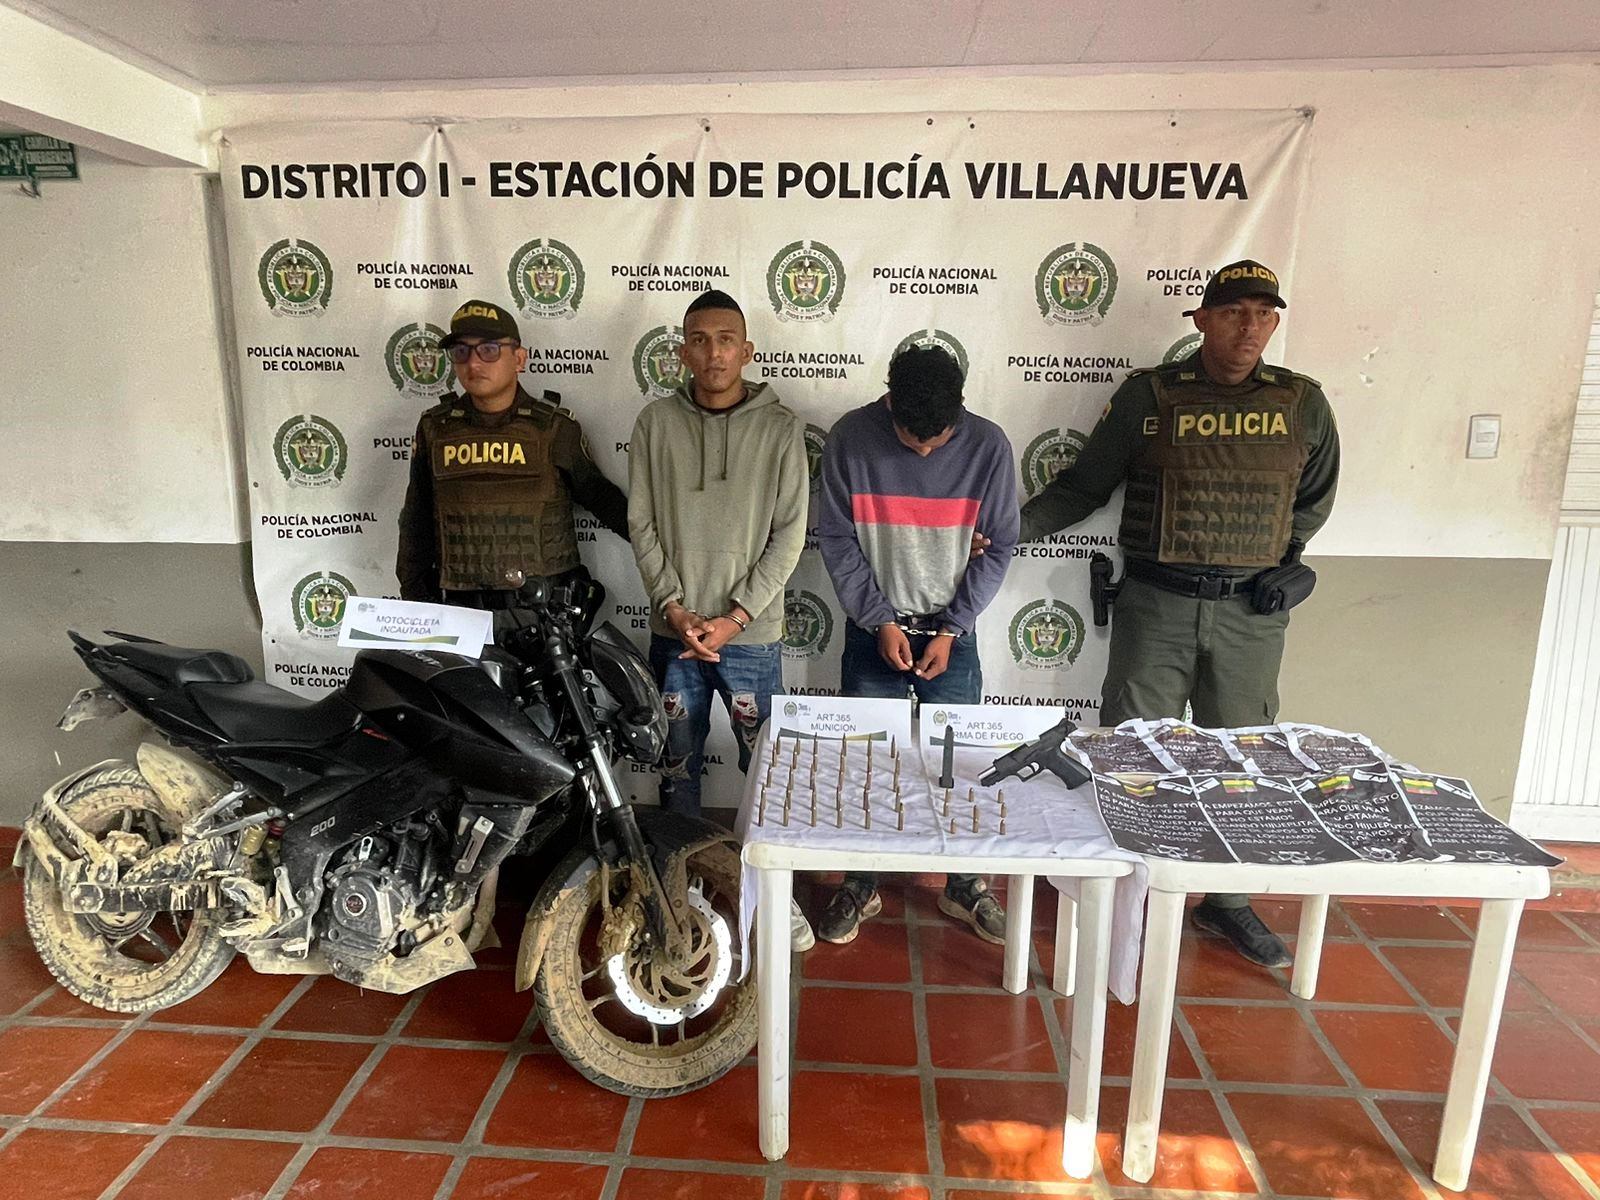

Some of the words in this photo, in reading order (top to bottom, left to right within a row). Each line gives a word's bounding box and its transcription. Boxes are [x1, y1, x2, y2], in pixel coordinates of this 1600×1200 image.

[241, 162, 428, 198] DISTRITO
[438, 162, 449, 197] I
[490, 153, 693, 198] ESTACIÓN
[709, 162, 764, 198] DE
[777, 153, 950, 199] POLICÍA
[965, 163, 1248, 200] VILLANUEVA
[357, 261, 407, 275] POLICÍA
[412, 264, 473, 275] NACIONAL
[611, 263, 660, 277] POLICÍA
[664, 266, 729, 277] NACIONAL
[873, 265, 925, 280] POLICÍA
[929, 268, 997, 280] NACIONAL
[1147, 267, 1201, 281] POLICÍA
[1219, 266, 1278, 284] POLICIA
[374, 278, 392, 289] DE
[396, 278, 458, 289] COLOMBIA
[628, 280, 644, 291] DE
[648, 280, 712, 291] COLOMBIA
[889, 283, 907, 295] DE
[911, 283, 979, 295] COLOMBIA
[1163, 285, 1182, 296] DE
[247, 344, 293, 357] POLICÍA
[297, 346, 360, 358] NACIONAL
[546, 350, 609, 361] NACIONAL
[753, 351, 795, 363] OLICÍA
[799, 354, 864, 365] NACIONAL
[1008, 354, 1059, 368] POLICÍA
[1064, 357, 1132, 369] NACIONAL
[263, 361, 279, 372] DE
[281, 361, 345, 372] COLOMBIA
[529, 363, 594, 374] COLOMBIA
[762, 367, 778, 378] DE
[781, 367, 848, 379] COLOMBIA
[1024, 371, 1041, 382] DE
[1045, 371, 1114, 383] COLOMBIA
[1178, 412, 1289, 437] POLICIA
[374, 436, 415, 448] POLIC
[392, 450, 409, 460] DE
[444, 442, 526, 467] POLICIA
[262, 515, 308, 526] POLICÍA
[312, 512, 378, 525] NACIONAL
[277, 530, 293, 539] DE
[296, 525, 363, 538] COLOMBIA
[1049, 535, 1116, 546] NACIONAL
[1012, 547, 1027, 557] DE
[1031, 548, 1096, 560] COLOMBIA
[616, 605, 650, 616] POLIC
[376, 615, 441, 626] MOTOCICLETA
[631, 619, 646, 629] DE
[380, 626, 431, 635] INCAUTADA
[275, 663, 319, 675] POLICÍA
[322, 666, 354, 676] NACI
[290, 677, 304, 686] DE
[307, 677, 350, 688] COLOM
[984, 695, 1032, 706] POLICÍA
[1036, 698, 1099, 709] NACIONAL
[810, 723, 857, 732] MUNICION
[967, 721, 1003, 730] ART.365
[953, 732, 974, 740] RMA
[975, 732, 988, 740] DE
[991, 732, 1024, 741] FUEGO
[632, 764, 646, 773] DE
[1318, 807, 1338, 815] ARA
[310, 816, 336, 837] 200
